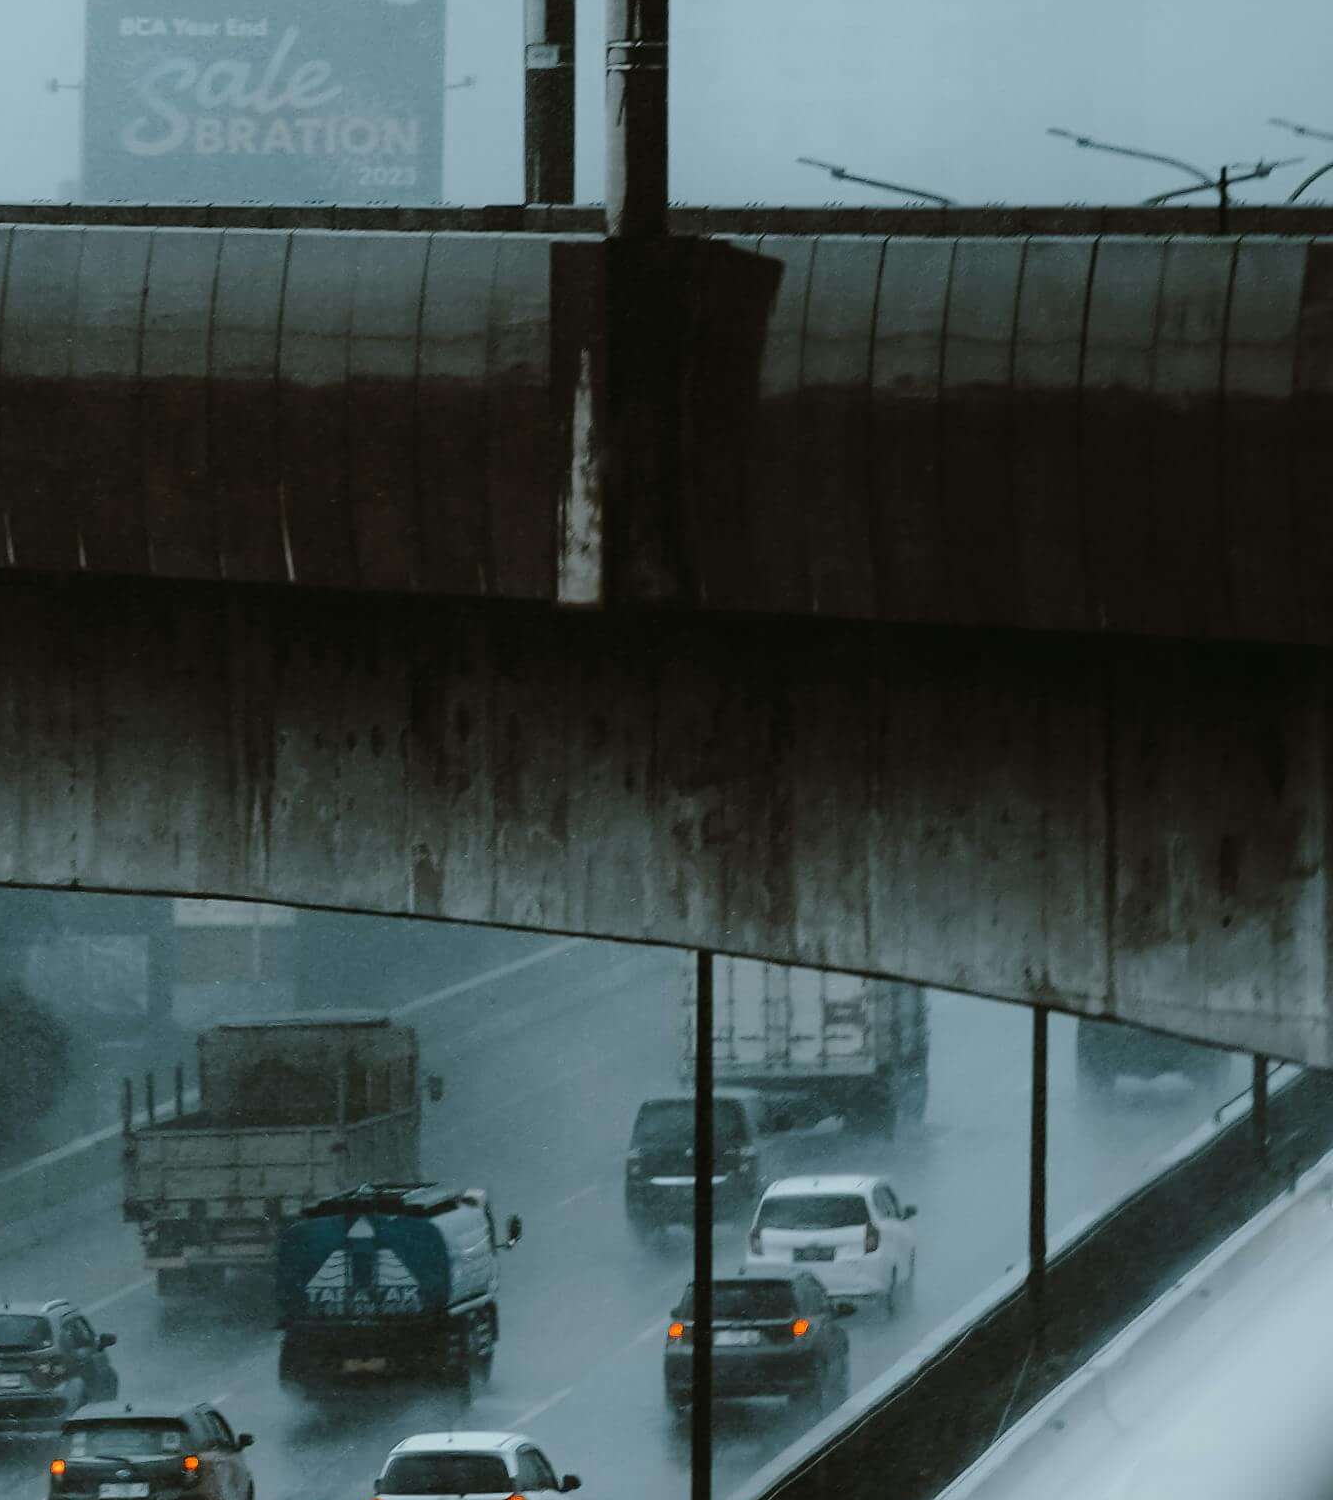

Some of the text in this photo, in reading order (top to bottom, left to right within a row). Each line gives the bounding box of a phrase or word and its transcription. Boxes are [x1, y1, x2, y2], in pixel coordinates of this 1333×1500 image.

[227, 17, 268, 36] End
[121, 24, 343, 156] Sale
[194, 118, 422, 155] BRATION
